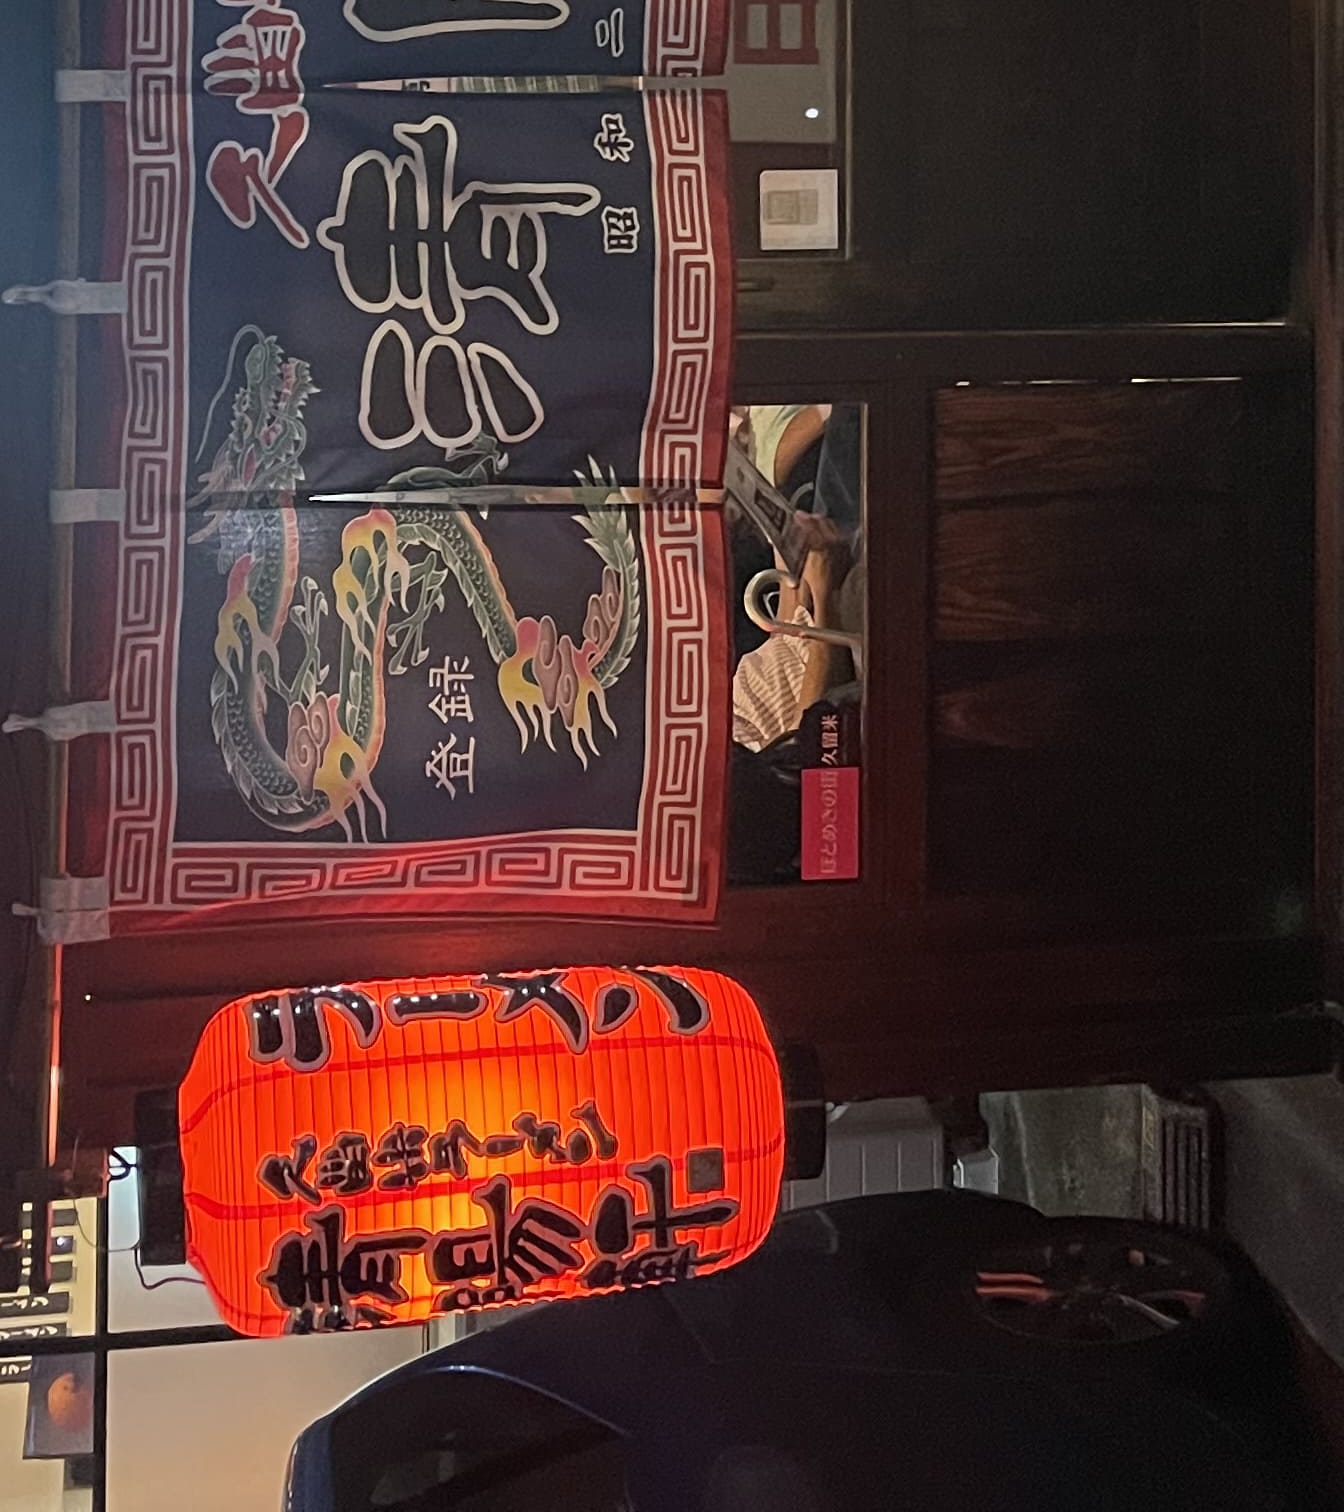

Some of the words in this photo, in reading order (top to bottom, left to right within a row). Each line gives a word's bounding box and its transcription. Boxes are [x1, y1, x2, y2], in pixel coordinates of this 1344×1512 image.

[424, 654, 476, 800] 登録
[820, 714, 839, 766] 久留米
[247, 965, 709, 1071] ラーメン
[257, 1100, 618, 1205] 久留米ラーメン
[257, 1155, 740, 1334] 清陽軒
